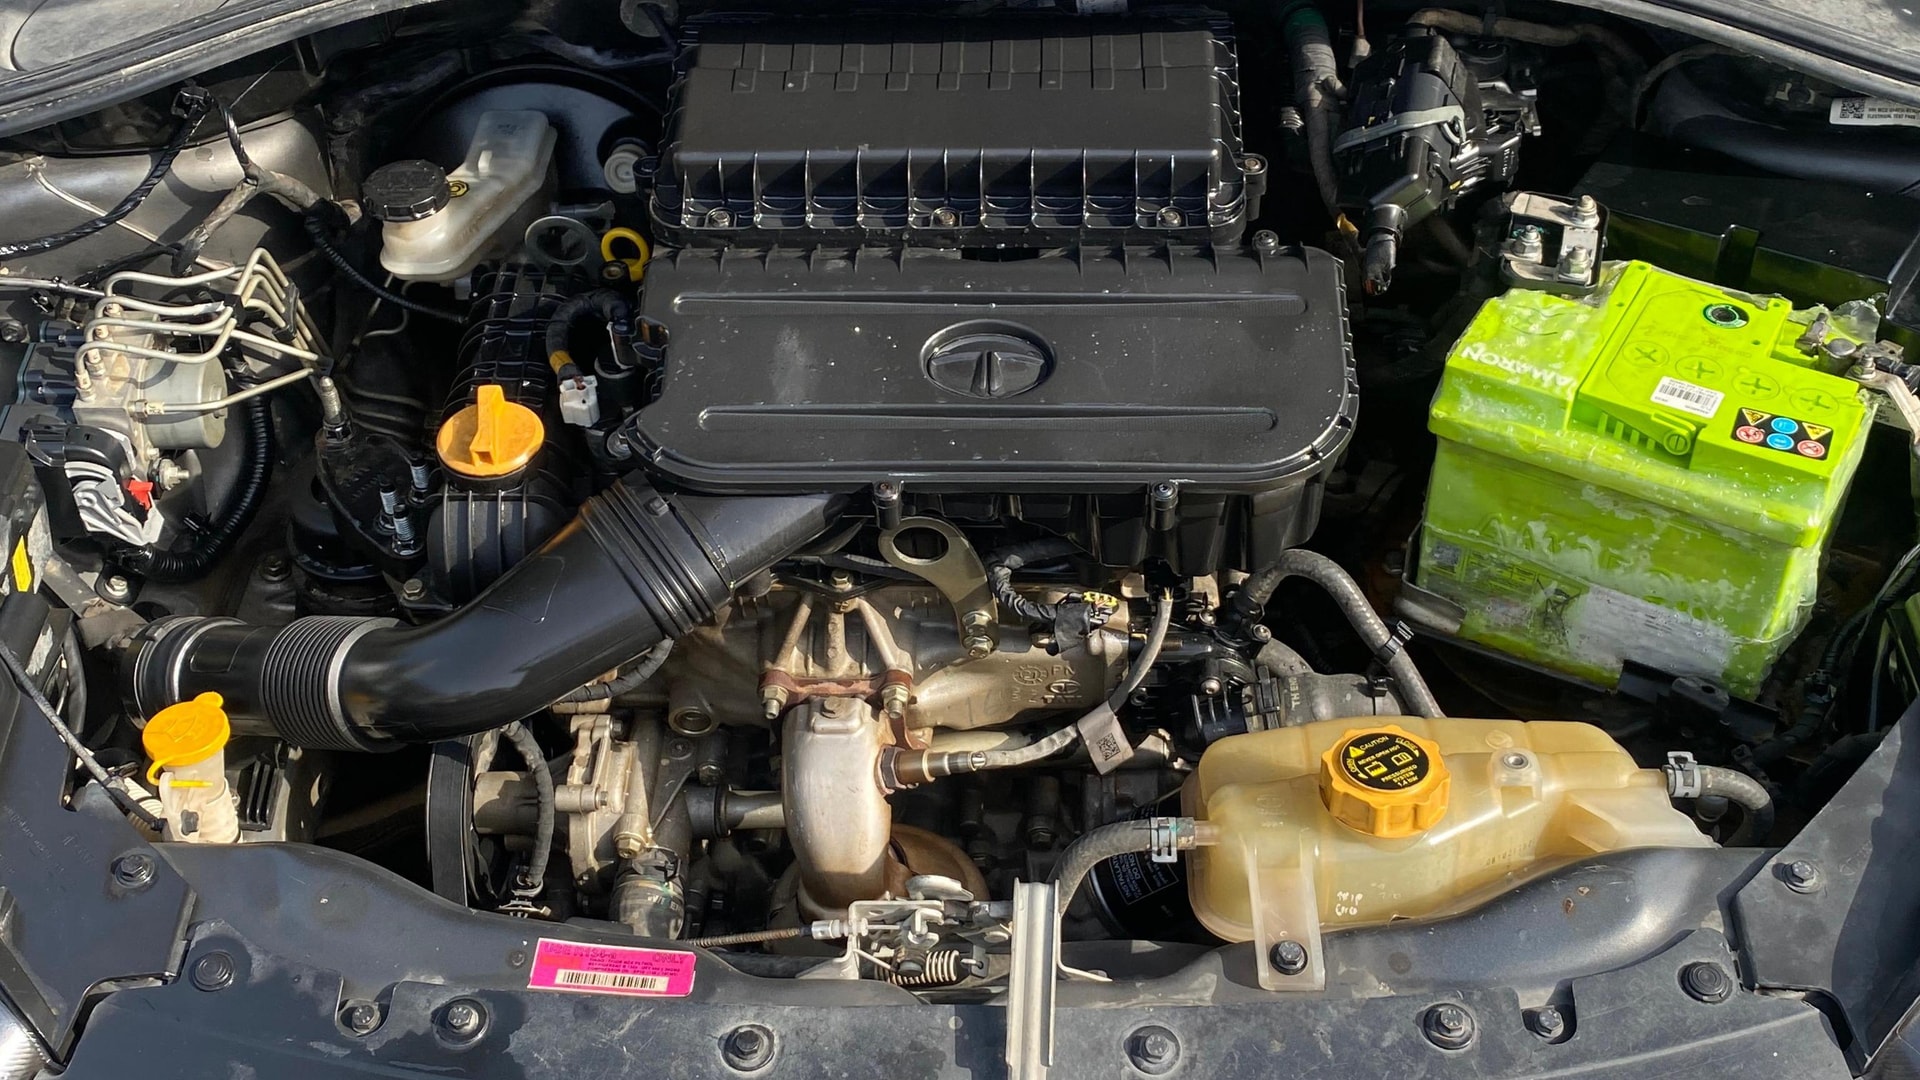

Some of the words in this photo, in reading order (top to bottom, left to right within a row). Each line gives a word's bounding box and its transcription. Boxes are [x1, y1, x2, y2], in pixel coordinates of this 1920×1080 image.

[1461, 345, 1575, 386] AMARON
[1360, 736, 1389, 750] CAUTION
[1358, 755, 1377, 765] NEVER
[652, 952, 684, 964] ONLY
